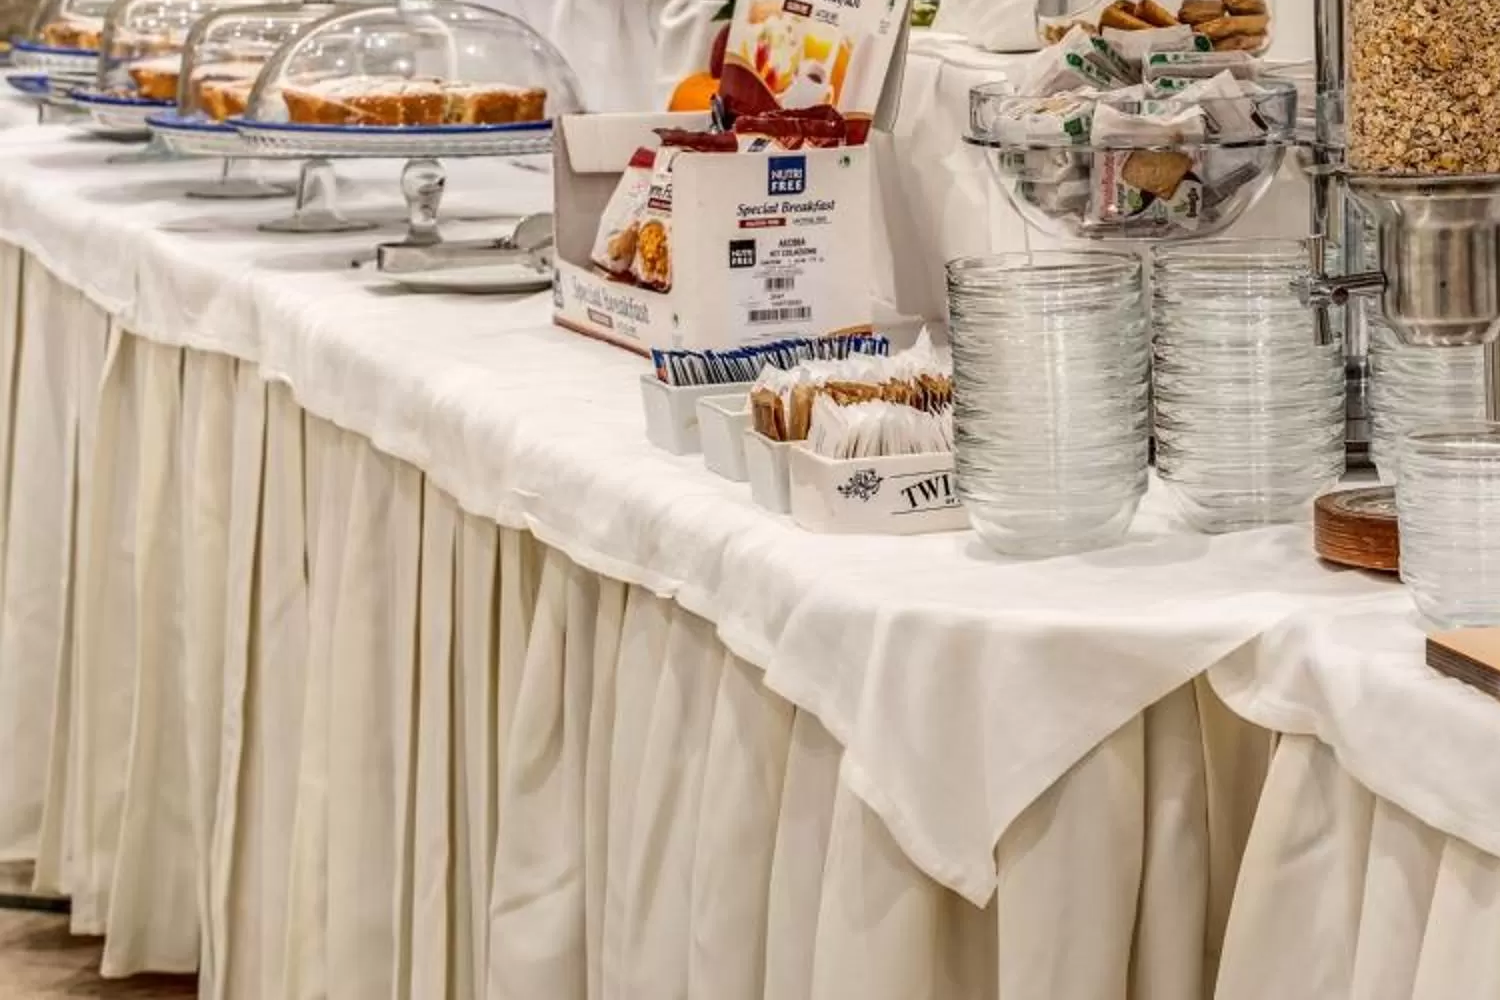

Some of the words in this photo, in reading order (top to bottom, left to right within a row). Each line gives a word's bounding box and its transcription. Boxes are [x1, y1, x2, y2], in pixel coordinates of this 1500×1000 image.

[771, 168, 802, 180] NUTRI
[771, 180, 802, 192] FREE
[737, 202, 779, 217] Special
[781, 199, 836, 213] Breakfast
[901, 474, 951, 508] TWI
